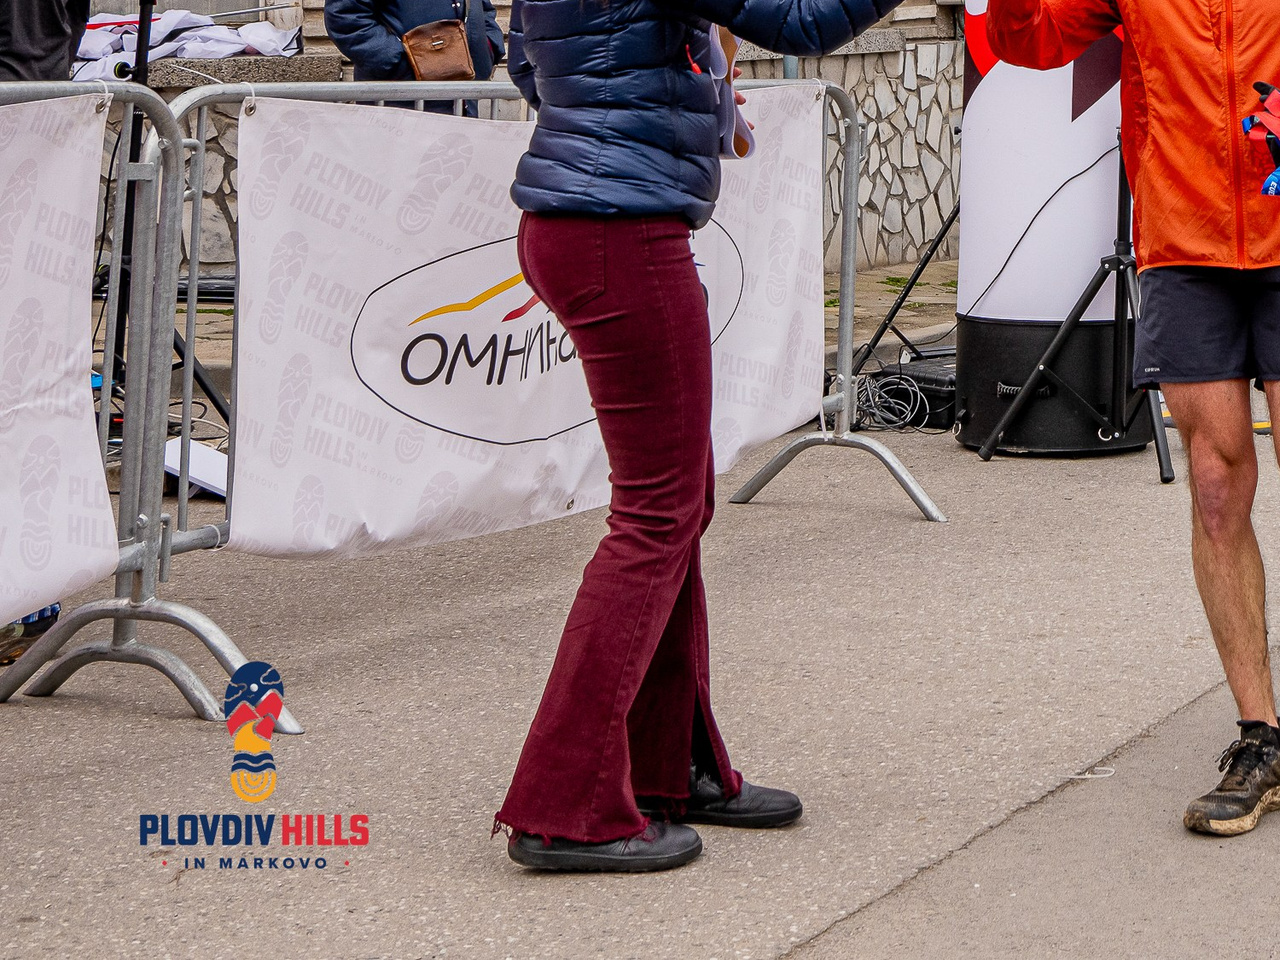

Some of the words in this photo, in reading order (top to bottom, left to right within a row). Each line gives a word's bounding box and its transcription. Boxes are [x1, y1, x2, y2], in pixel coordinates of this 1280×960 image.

[304, 151, 392, 211] PLOVDIV
[34, 202, 92, 251] PLOVD
[290, 183, 350, 230] HILLS
